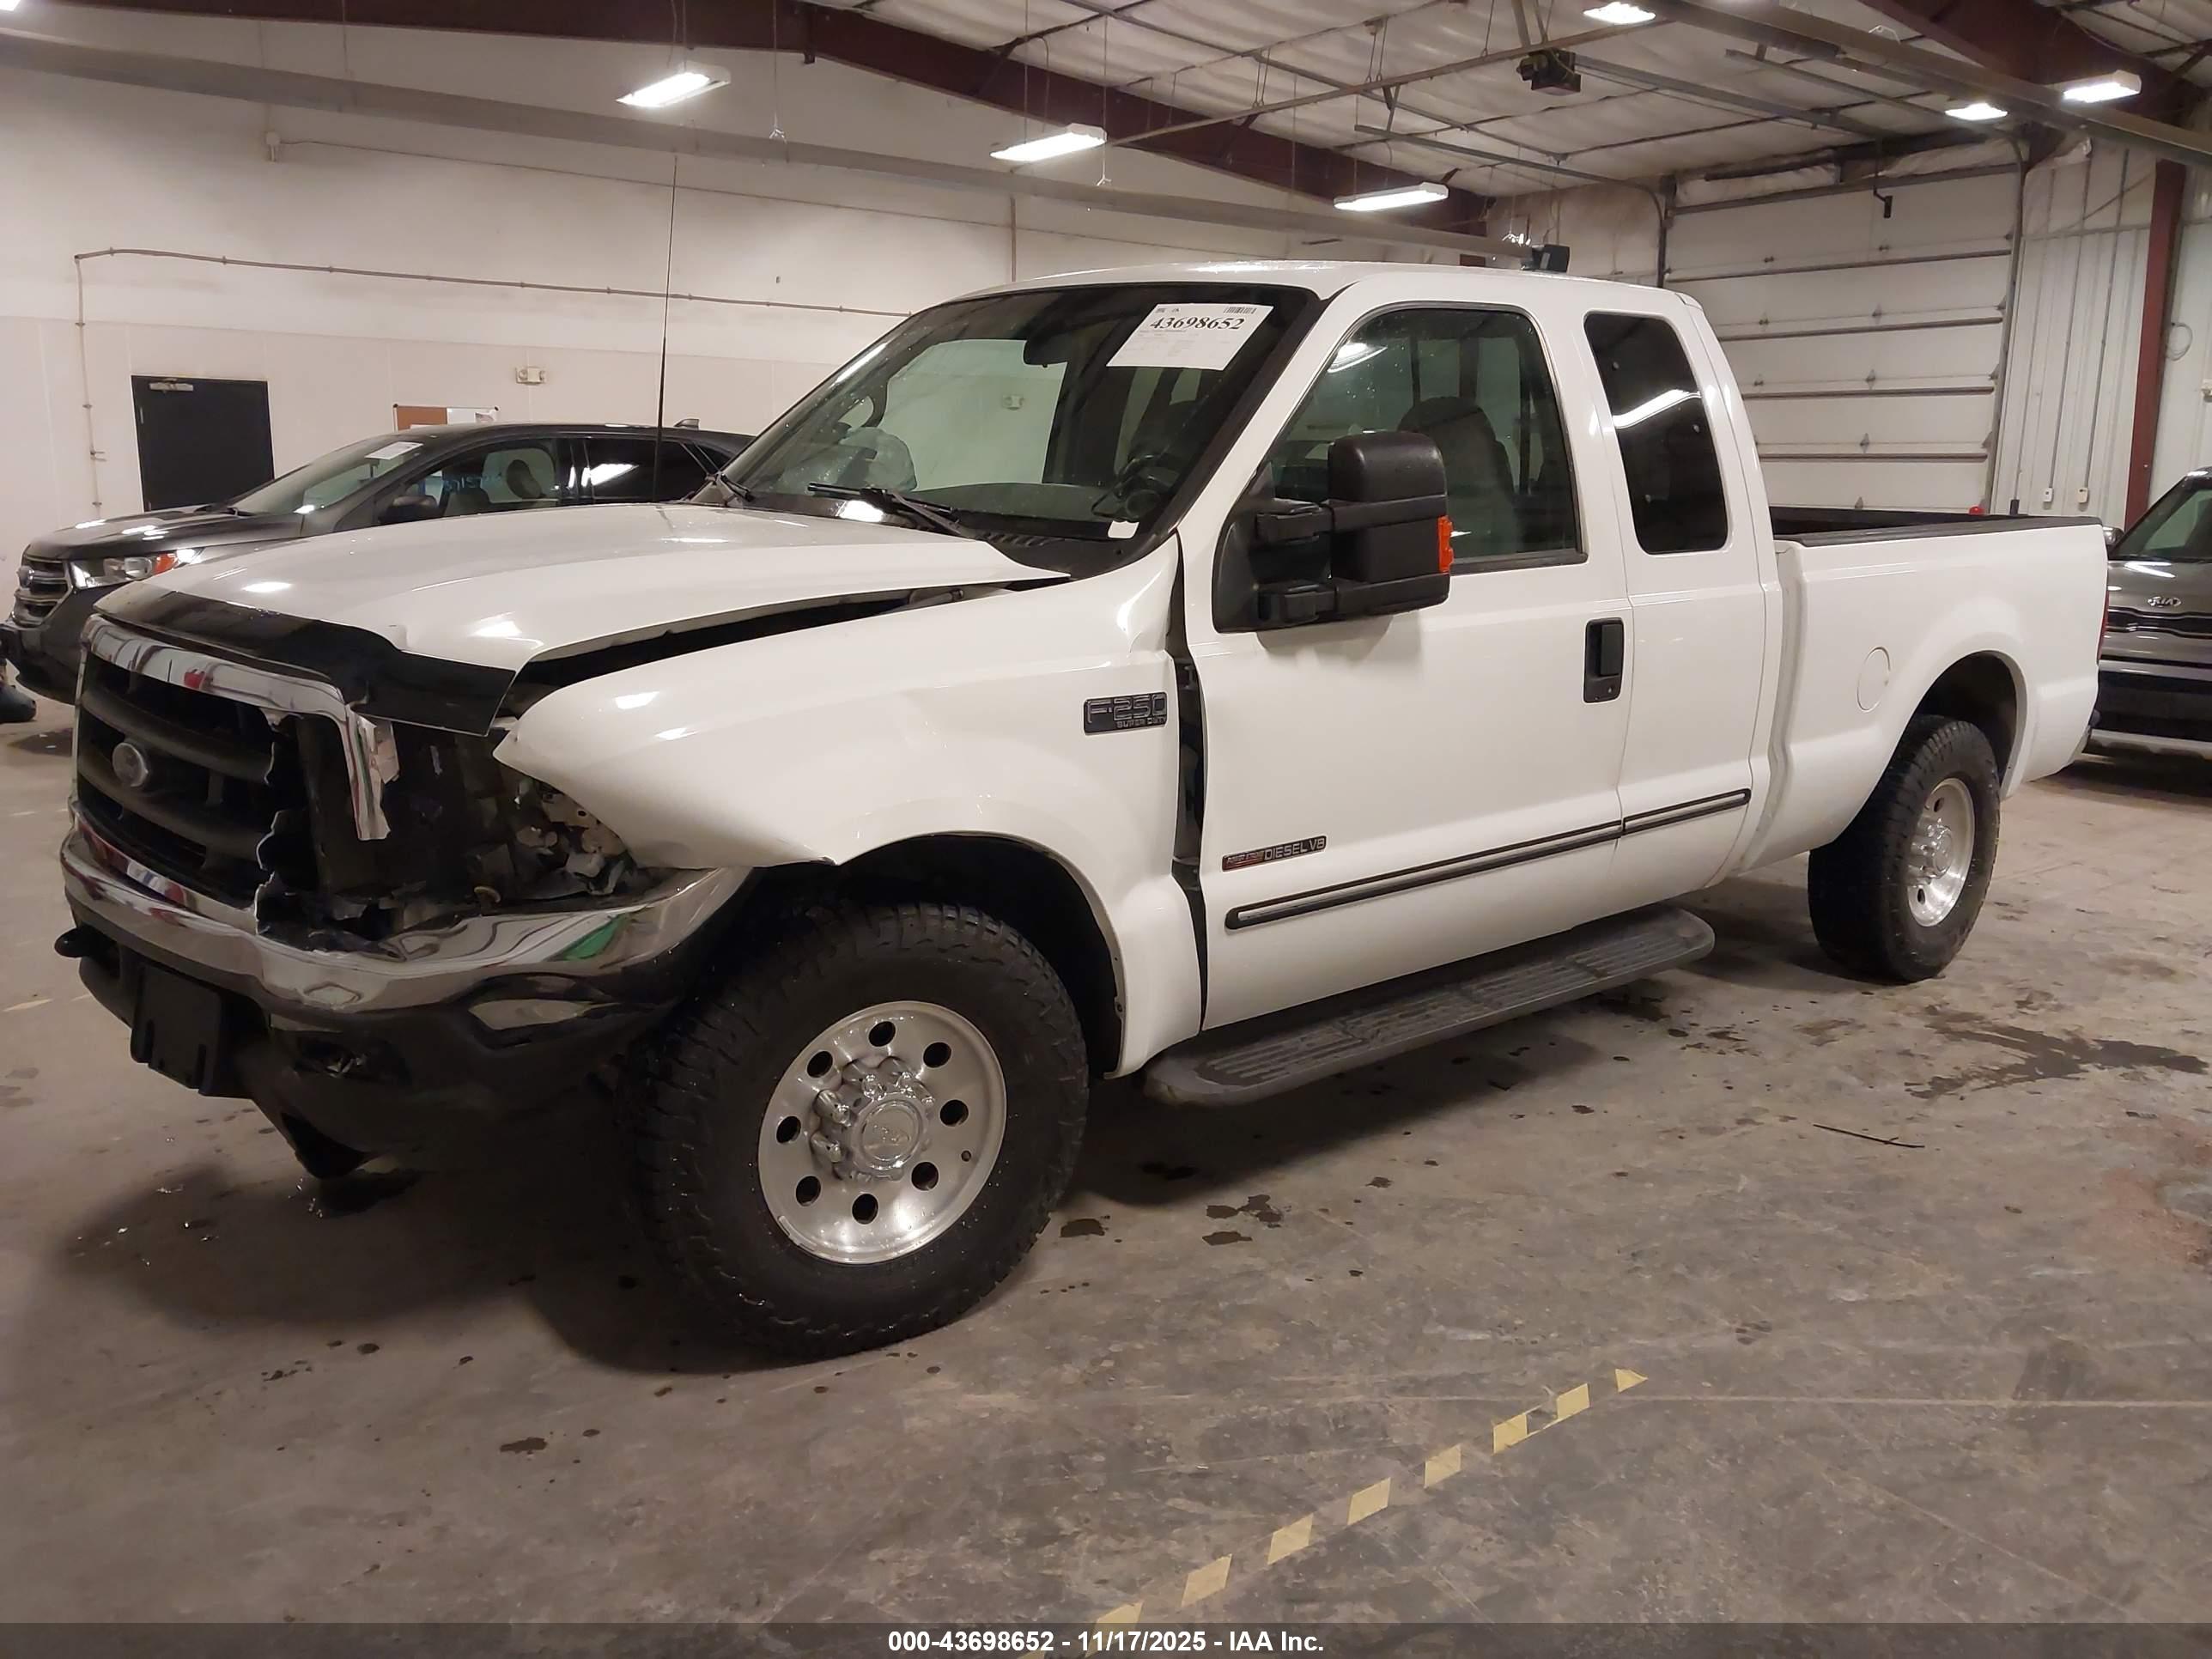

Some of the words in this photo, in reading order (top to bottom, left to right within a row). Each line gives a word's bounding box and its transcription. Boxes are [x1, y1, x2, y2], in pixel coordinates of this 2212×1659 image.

[1151, 316, 1245, 330] 43698652
[1264, 842, 1308, 860] DIESEL
[1310, 838, 1325, 851] V8
